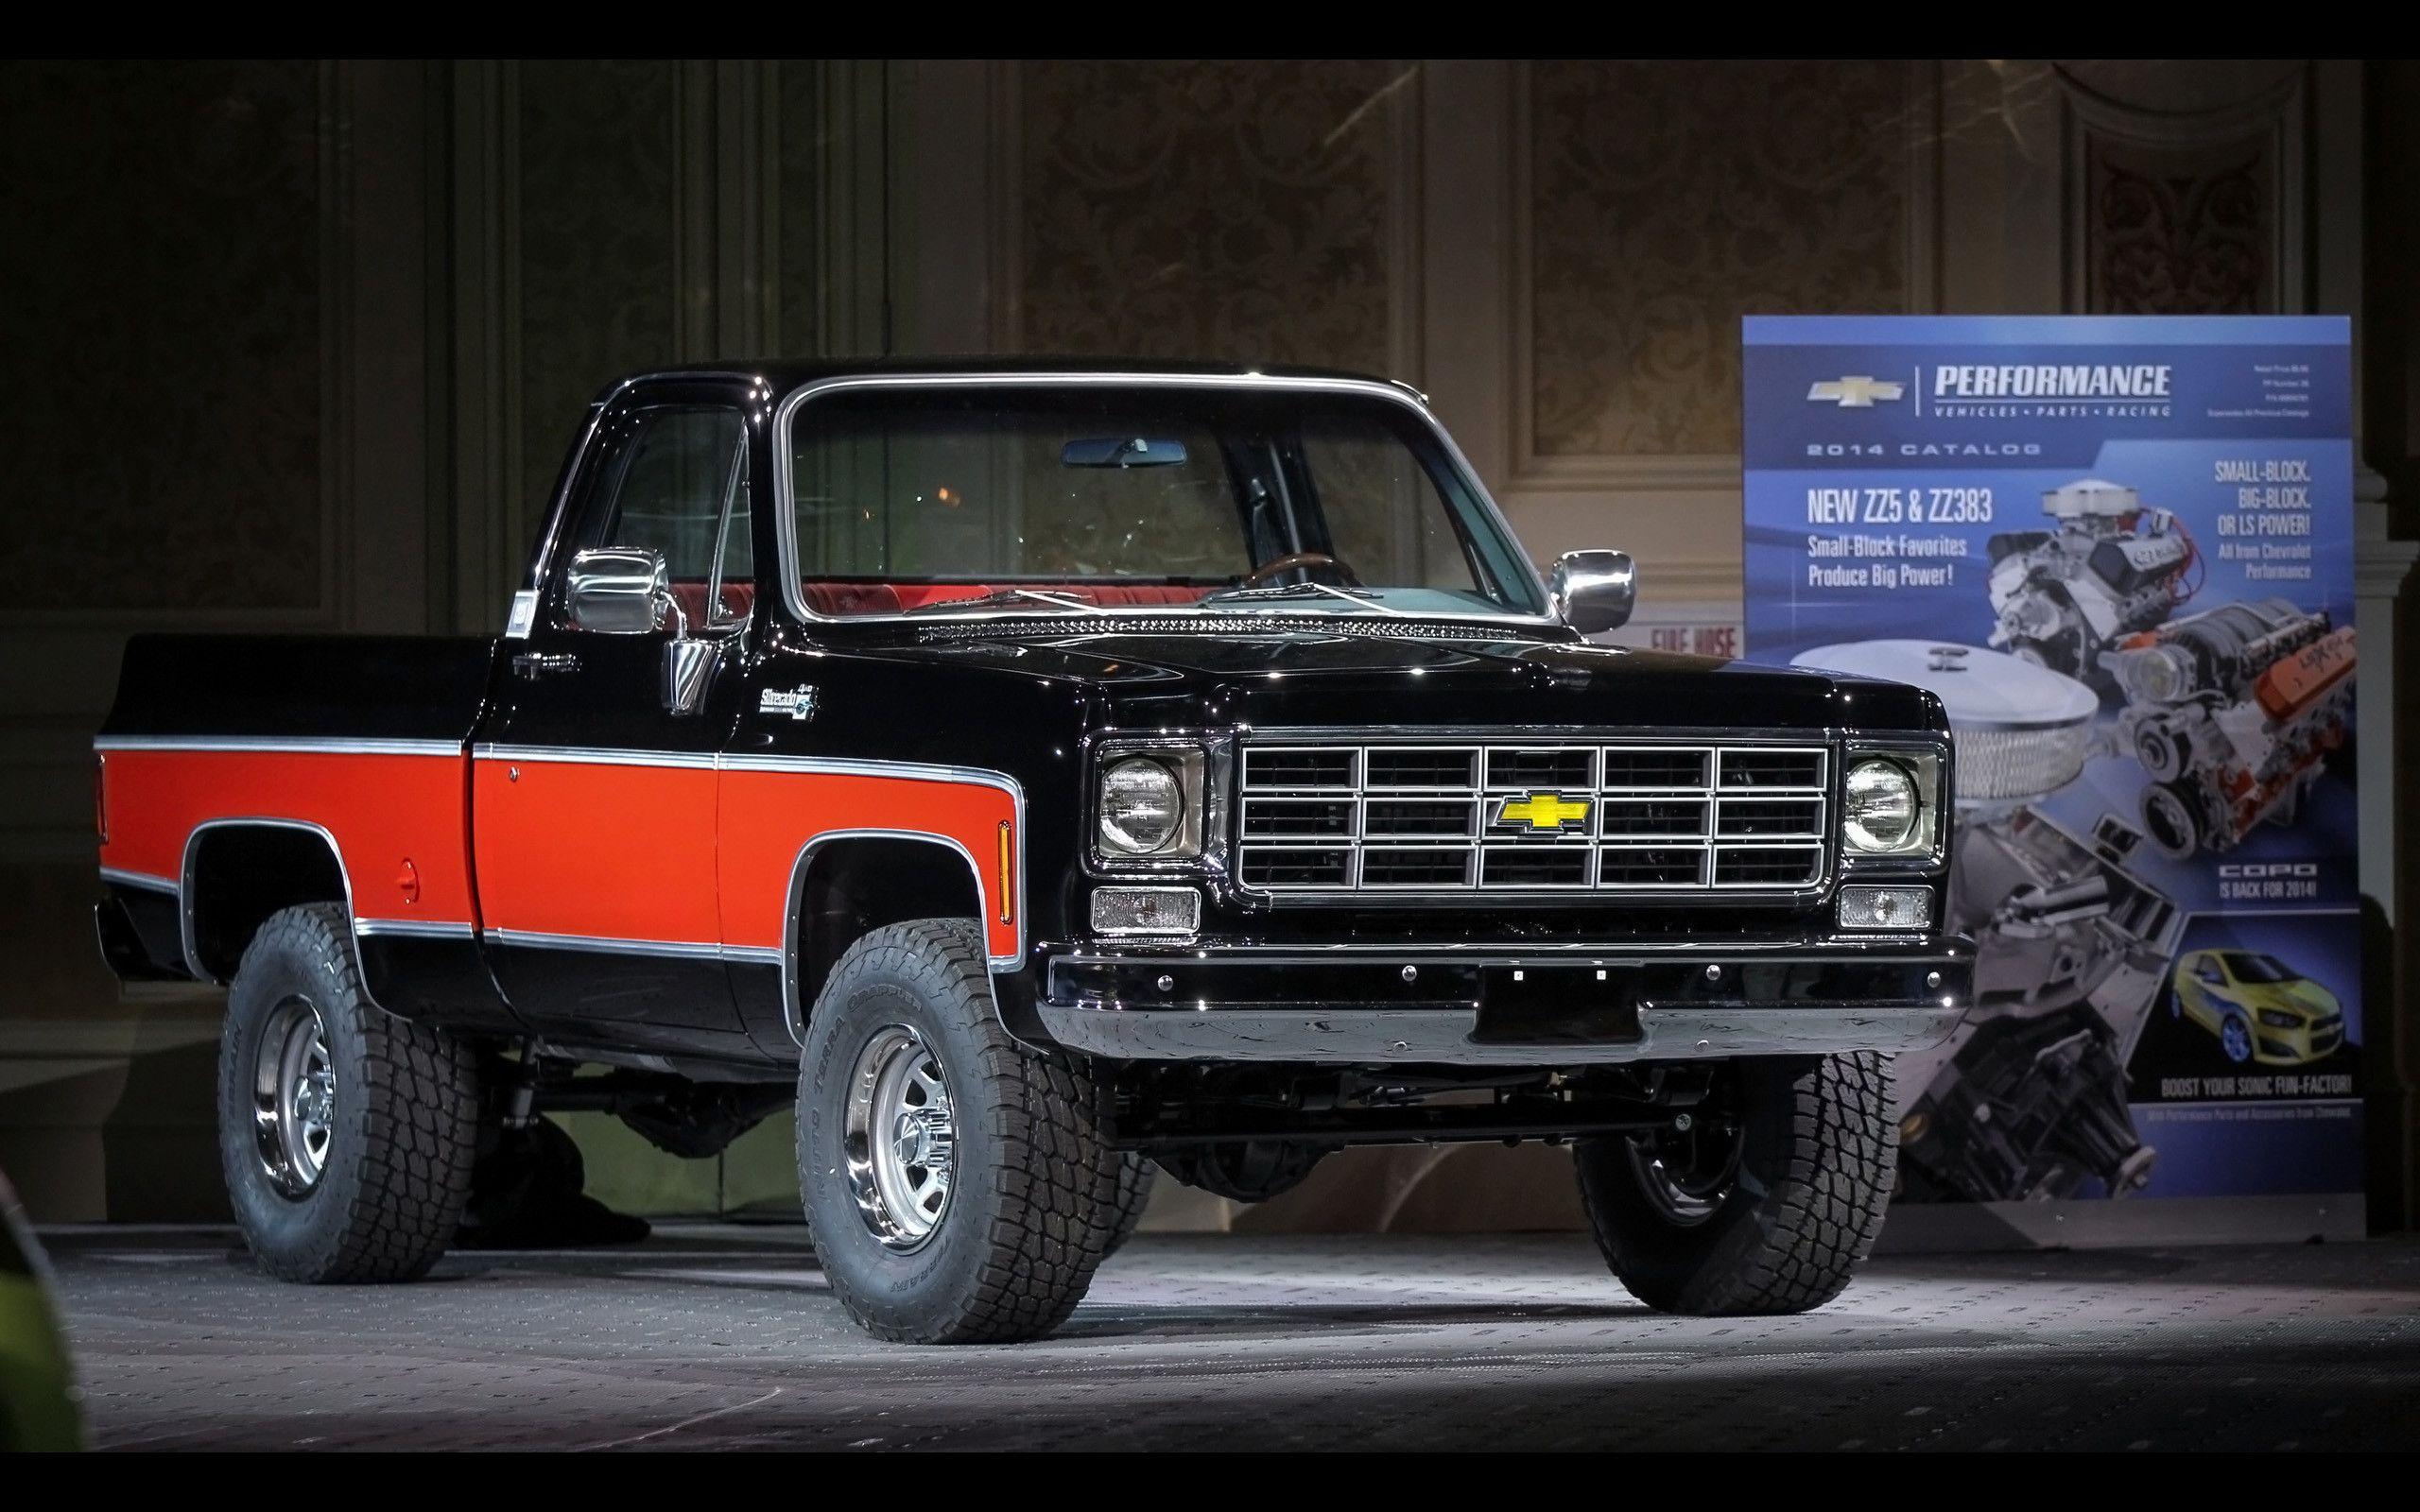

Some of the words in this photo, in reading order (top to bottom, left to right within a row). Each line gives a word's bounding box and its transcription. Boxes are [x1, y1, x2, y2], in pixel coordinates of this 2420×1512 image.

[1934, 365, 2171, 396] PERFORMANCE
[1935, 406, 2017, 418] VEHICLES
[2036, 406, 2088, 418] PARTS
[2106, 406, 2171, 417] RACING
[1806, 444, 1884, 455] 2014
[1901, 444, 2043, 455] CATALOG
[1807, 489, 1858, 524] NEW
[1864, 489, 1902, 524] ZZ5
[1908, 489, 1923, 524] &
[1928, 488, 1993, 524] ZZ383
[2218, 515, 2237, 537] OR
[2238, 515, 2256, 537] LS
[2257, 514, 2310, 536] POWER!
[1807, 535, 1895, 558] Small-Block
[1900, 535, 1968, 557] Favorites
[2218, 543, 2233, 559] All
[2236, 542, 2260, 559] from
[2262, 542, 2311, 559] Chevrolet
[1808, 564, 1868, 586] Produce
[1872, 563, 1896, 589] Big
[1900, 563, 1954, 585] Power!
[2245, 562, 2312, 579] Performance
[2219, 864, 2317, 878] COPO
[2220, 882, 2230, 898] IS
[2233, 882, 2260, 898] BACK
[2263, 882, 2284, 898] FOR
[2161, 1077, 2199, 1097] BOOST
[2203, 1077, 2236, 1095] YOUR
[2238, 1076, 2273, 1095] SONIC
